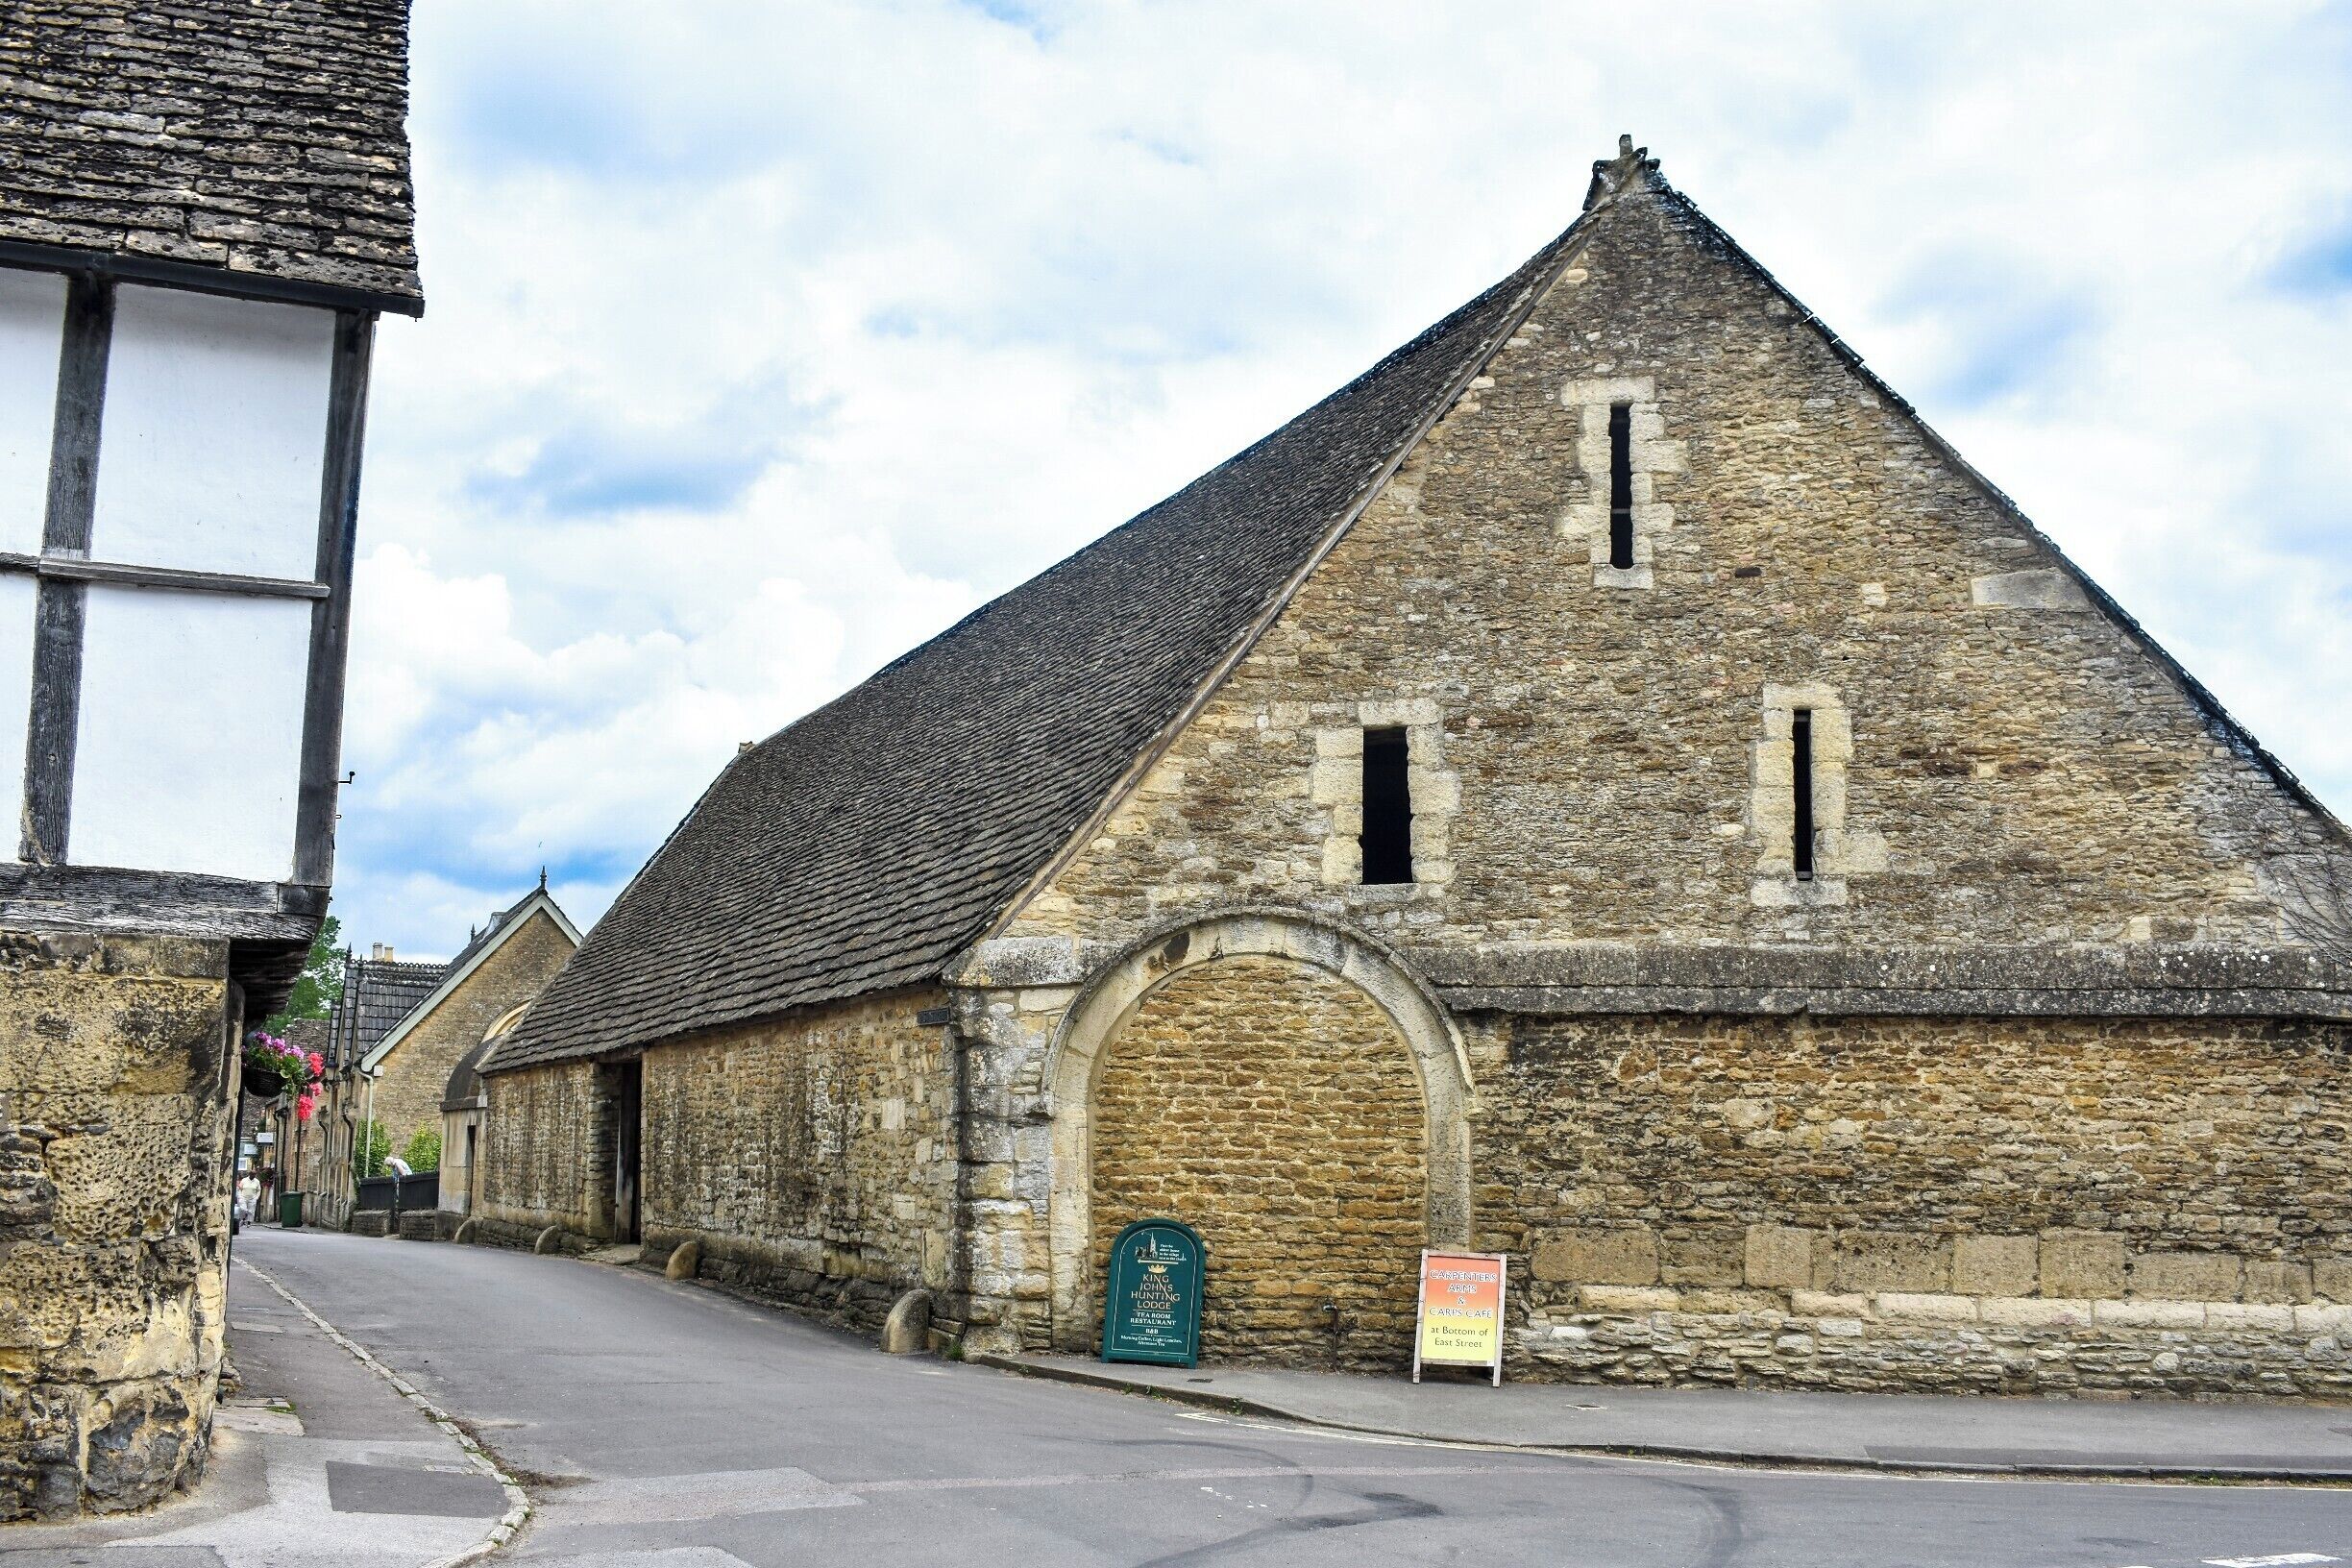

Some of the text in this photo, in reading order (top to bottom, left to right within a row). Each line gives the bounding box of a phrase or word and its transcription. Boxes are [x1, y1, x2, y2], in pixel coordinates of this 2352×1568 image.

[1142, 1274, 1169, 1283] KING
[1429, 1269, 1498, 1283] CARPENTERS
[1139, 1283, 1174, 1292] JOHNS
[1447, 1284, 1478, 1293] ARMS
[1131, 1290, 1181, 1302] HUNTING
[1457, 1296, 1466, 1305] &
[1137, 1300, 1171, 1310] LODGE
[1442, 1326, 1476, 1335] Bottom
[1479, 1328, 1488, 1336] of
[1434, 1337, 1482, 1348] East Street
